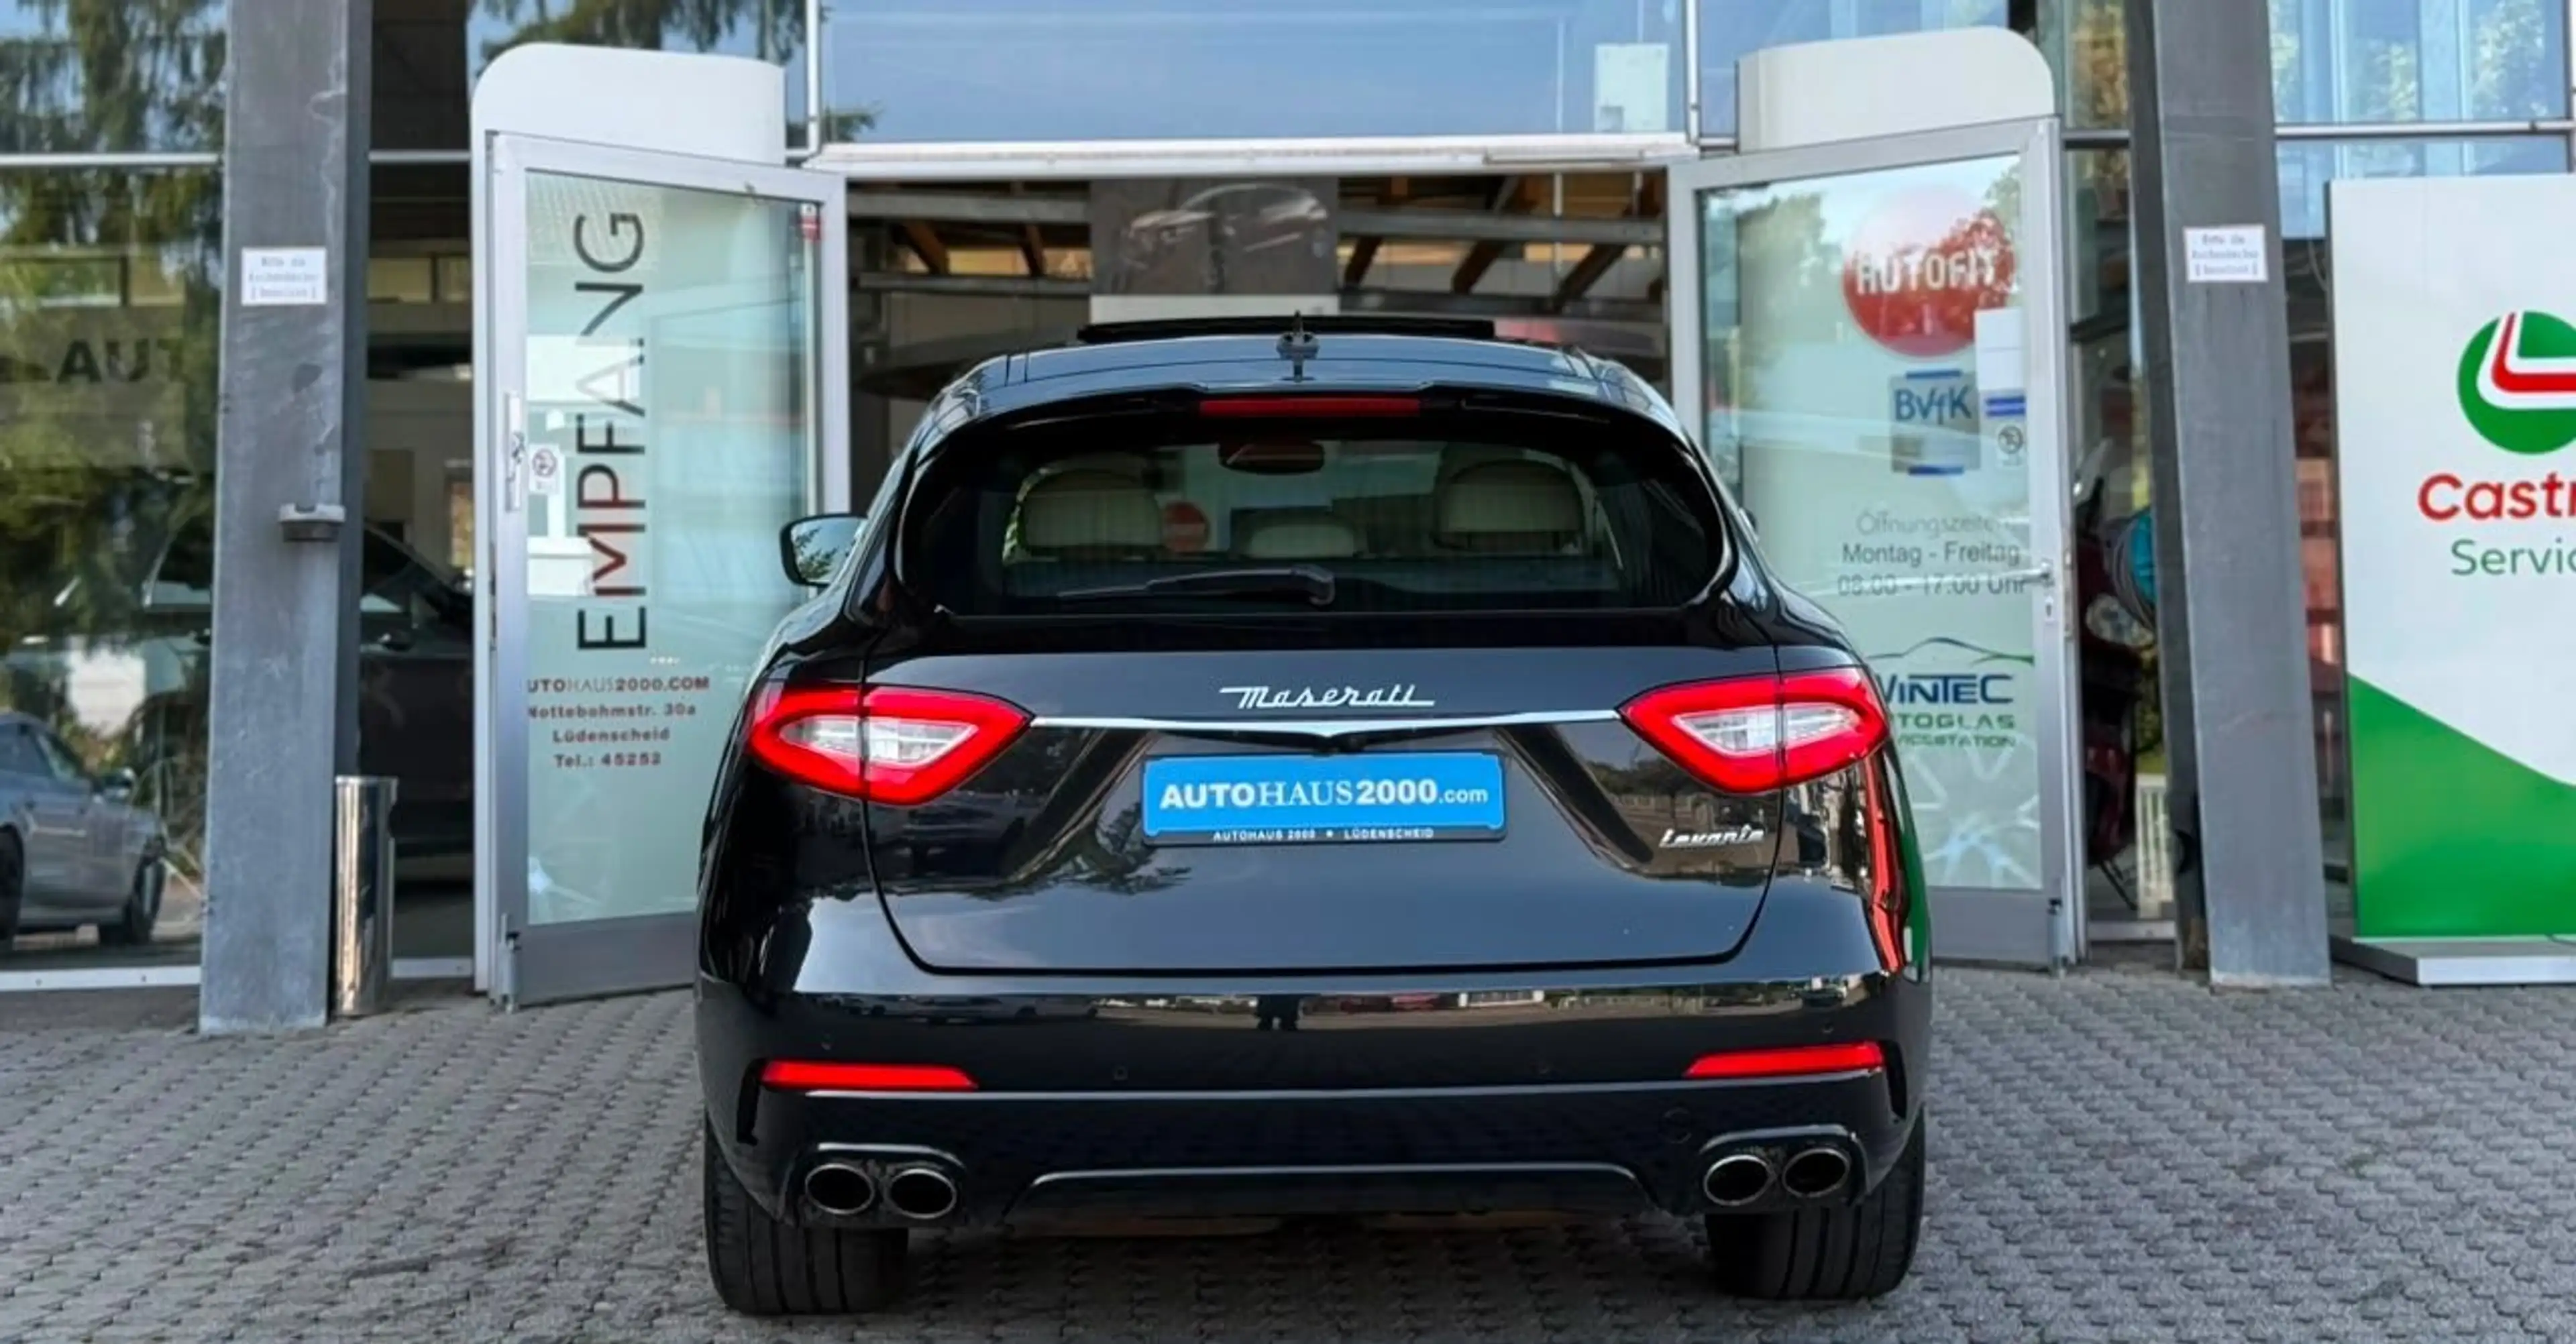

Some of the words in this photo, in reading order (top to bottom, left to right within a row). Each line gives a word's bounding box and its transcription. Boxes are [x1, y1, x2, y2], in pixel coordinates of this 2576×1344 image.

[1855, 248, 1999, 294] AUTOFIT
[574, 211, 647, 651] EMPFANG
[1842, 541, 1922, 568] Montag
[1944, 540, 2020, 567] Freitag
[527, 677, 710, 693] UTOHAUS2000.COM
[1220, 684, 1435, 709] Maserati
[1890, 712, 2016, 729] TOGLAS
[552, 726, 670, 744] Lüdenscheid
[1160, 779, 1489, 809] AUTOHAUS2000.com
[1213, 830, 1283, 842] AUTOHAUS
[1344, 828, 1434, 840] LÜDENSCHEID
[1659, 824, 1764, 848] Levante
